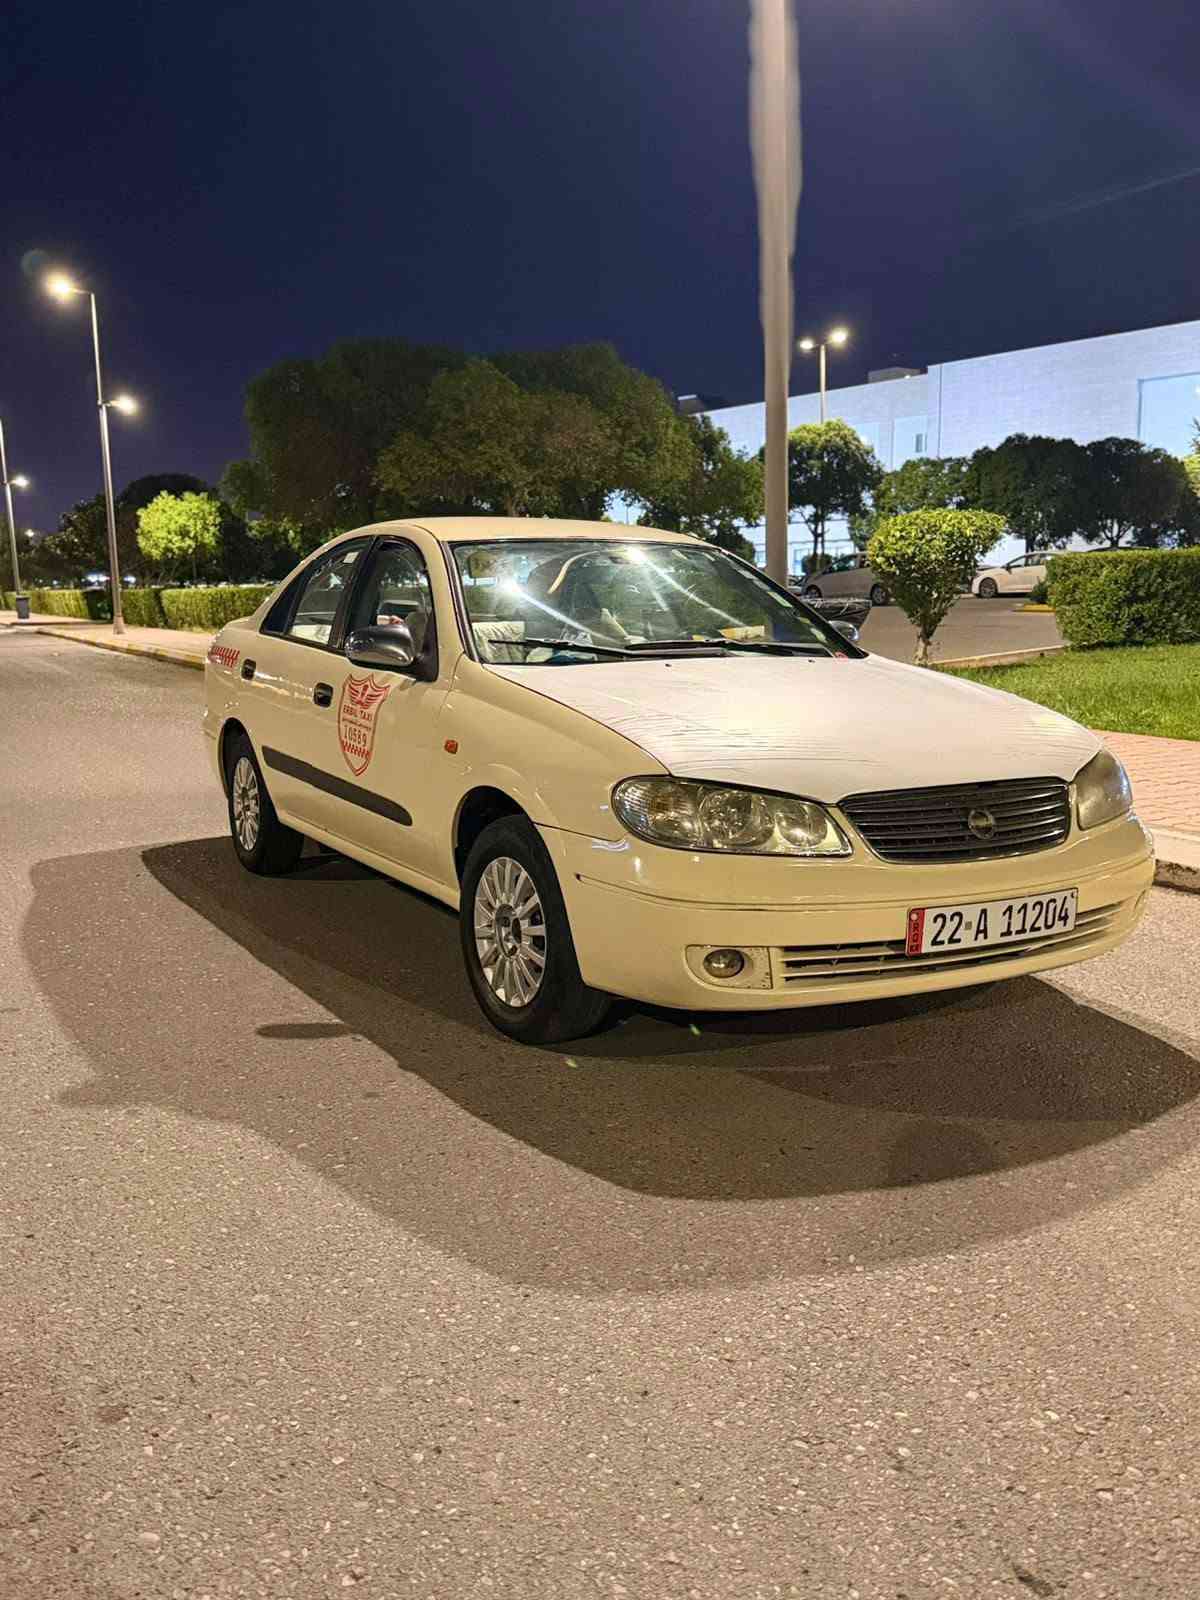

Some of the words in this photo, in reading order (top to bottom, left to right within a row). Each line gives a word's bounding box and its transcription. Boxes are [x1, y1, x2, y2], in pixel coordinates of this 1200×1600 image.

[931, 911, 964, 946] 22
[974, 908, 988, 941] A
[1000, 896, 1069, 938] 11204
